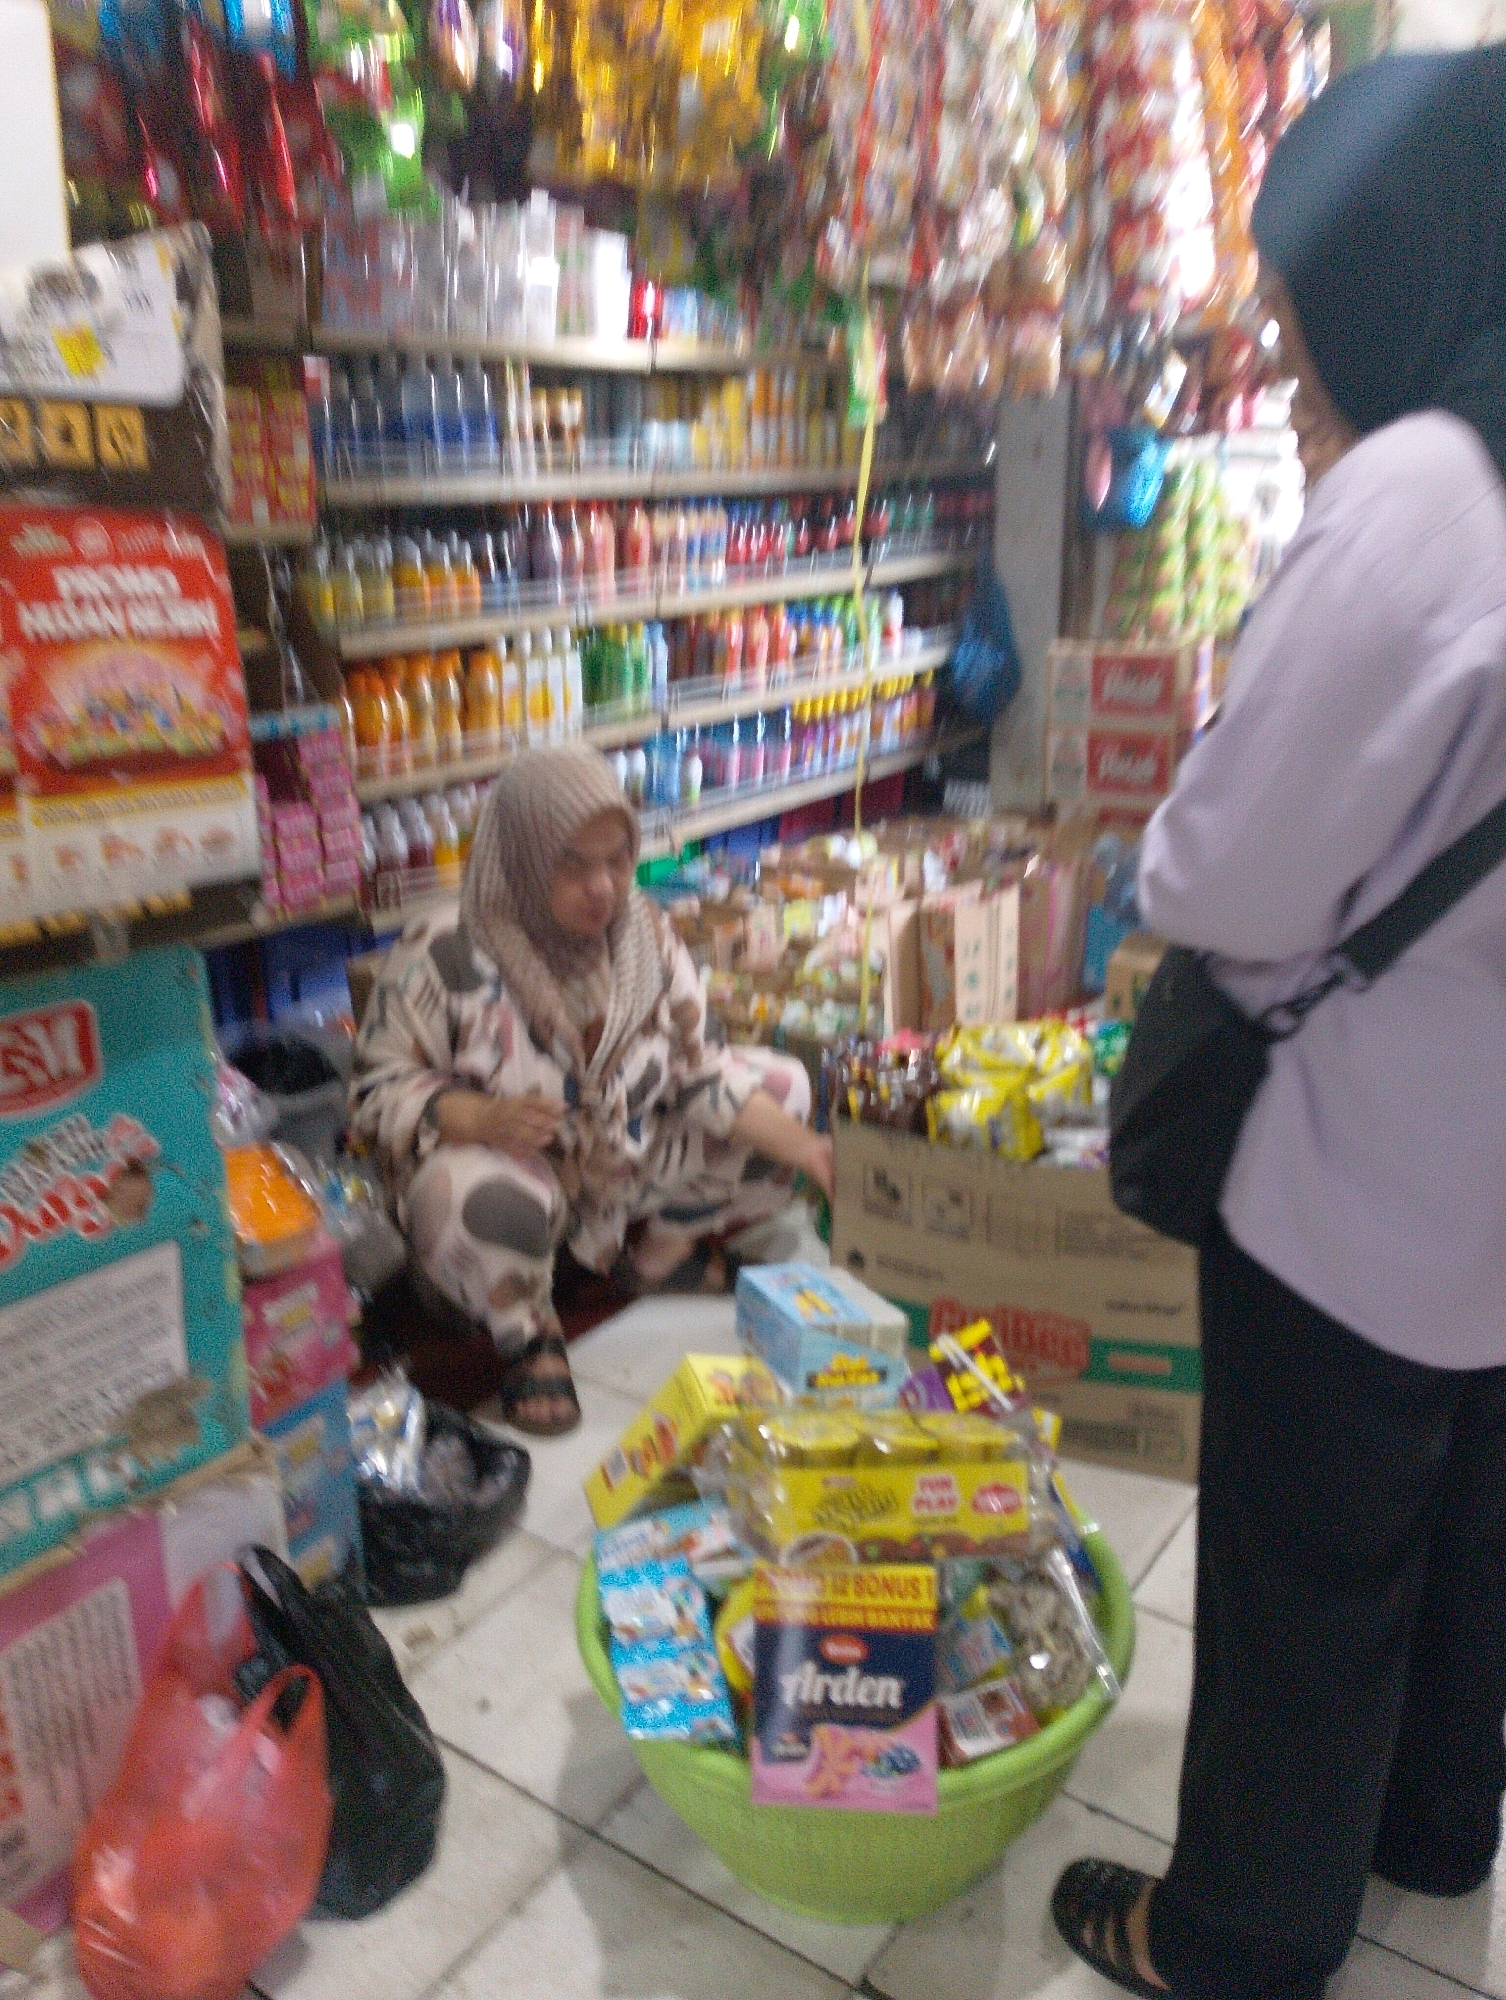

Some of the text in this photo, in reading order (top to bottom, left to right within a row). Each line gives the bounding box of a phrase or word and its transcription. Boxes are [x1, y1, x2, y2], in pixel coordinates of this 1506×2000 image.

[53, 565, 181, 602] PROMO
[853, 1573, 921, 1599] BONUS
[779, 1660, 903, 1710] Arden
